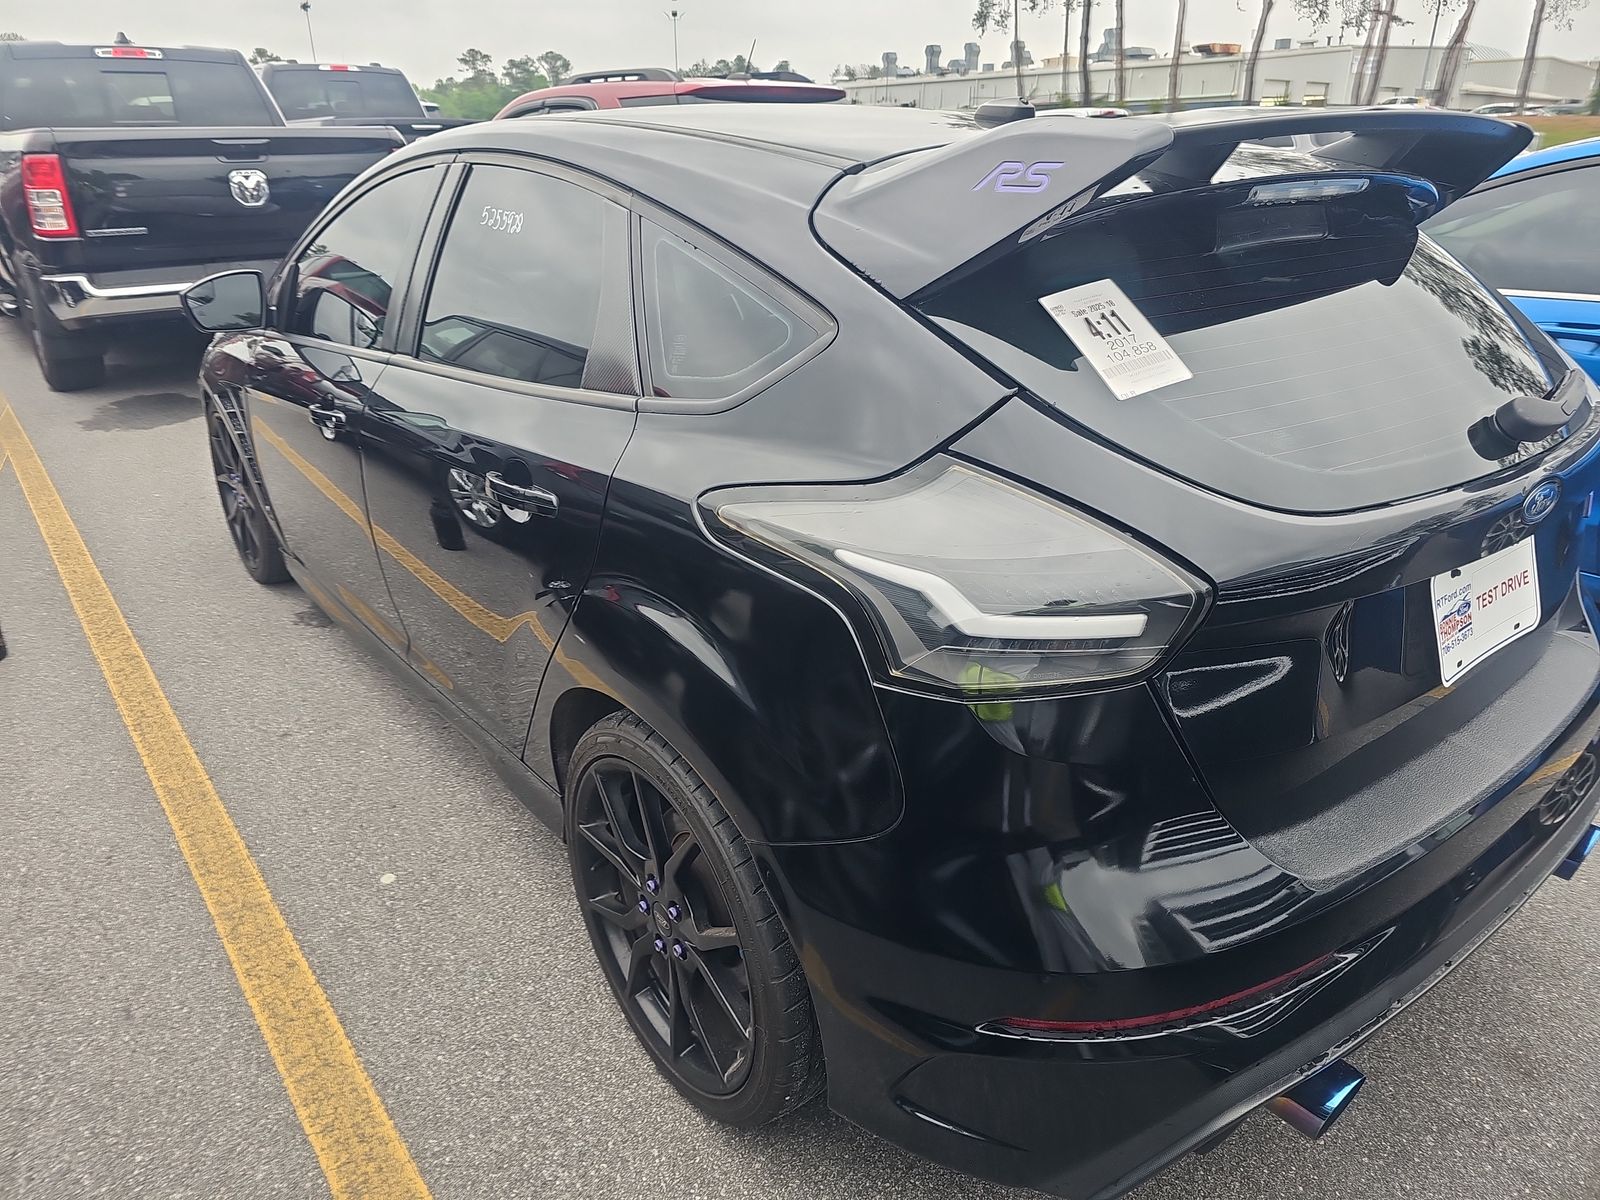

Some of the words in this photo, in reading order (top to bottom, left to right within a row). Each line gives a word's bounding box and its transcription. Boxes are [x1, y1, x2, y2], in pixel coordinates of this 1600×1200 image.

[969, 160, 1065, 193] RS
[1071, 308, 1089, 318] Sale
[1087, 302, 1106, 313] 2025
[1084, 309, 1132, 340] 4:11
[1106, 333, 1137, 351] 2017
[1107, 341, 1157, 363] 104,858
[1436, 583, 1472, 609] RTFord.com
[1475, 585, 1499, 611] TEST
[1501, 569, 1530, 597] DRIVE
[1440, 612, 1473, 640] THOMPSON
